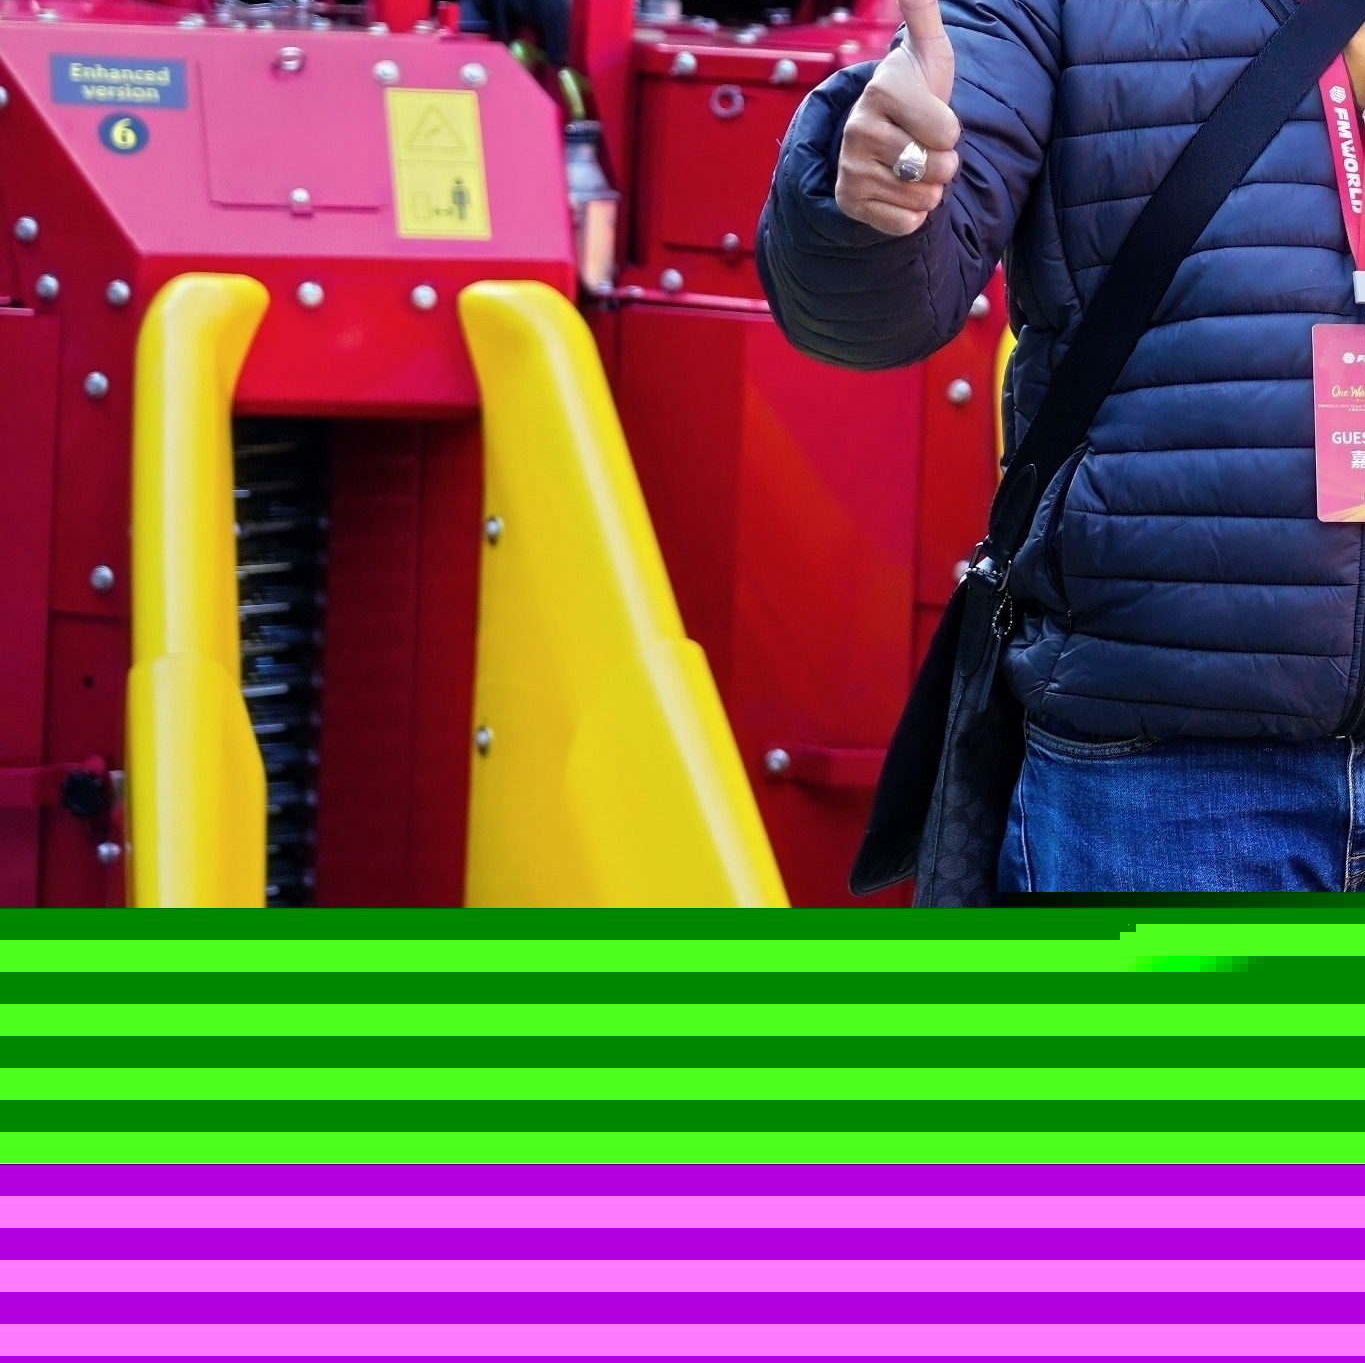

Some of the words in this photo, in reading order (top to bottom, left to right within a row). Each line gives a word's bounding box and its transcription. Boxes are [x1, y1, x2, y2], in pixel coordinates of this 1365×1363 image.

[69, 62, 171, 86] Enhanced
[81, 84, 160, 103] version
[110, 117, 138, 150] 6
[1334, 107, 1363, 214] FMWORLD
[1331, 385, 1349, 397] One
